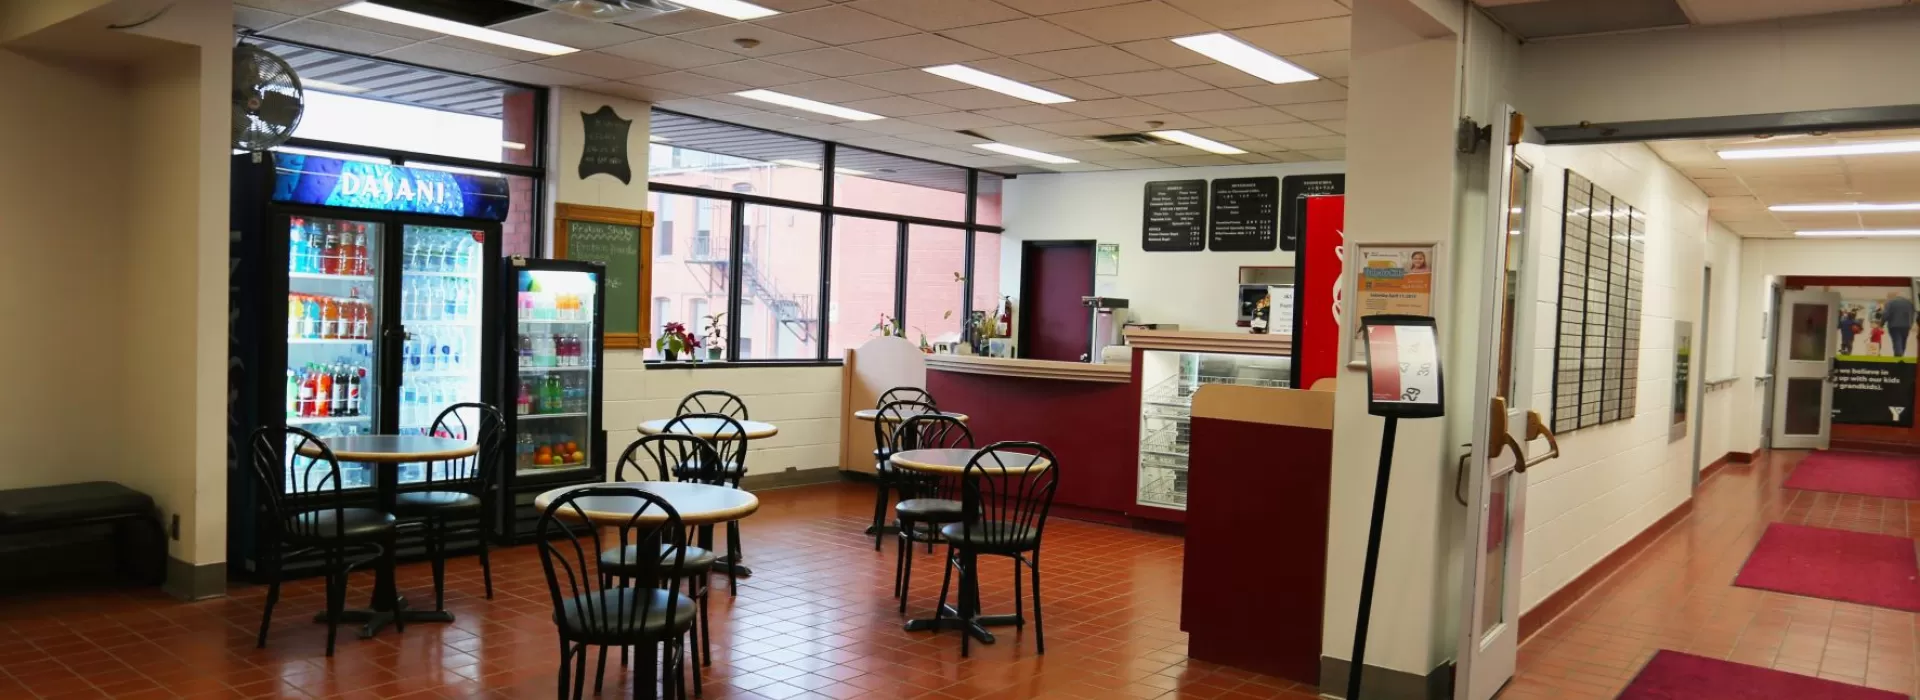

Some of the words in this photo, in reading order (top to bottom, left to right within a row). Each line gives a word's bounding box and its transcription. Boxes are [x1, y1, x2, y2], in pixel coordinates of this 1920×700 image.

[341, 171, 444, 205] DASANI
[1850, 375, 1867, 383] with
[1883, 376, 1900, 384] kids
[1401, 387, 1421, 402] 29
